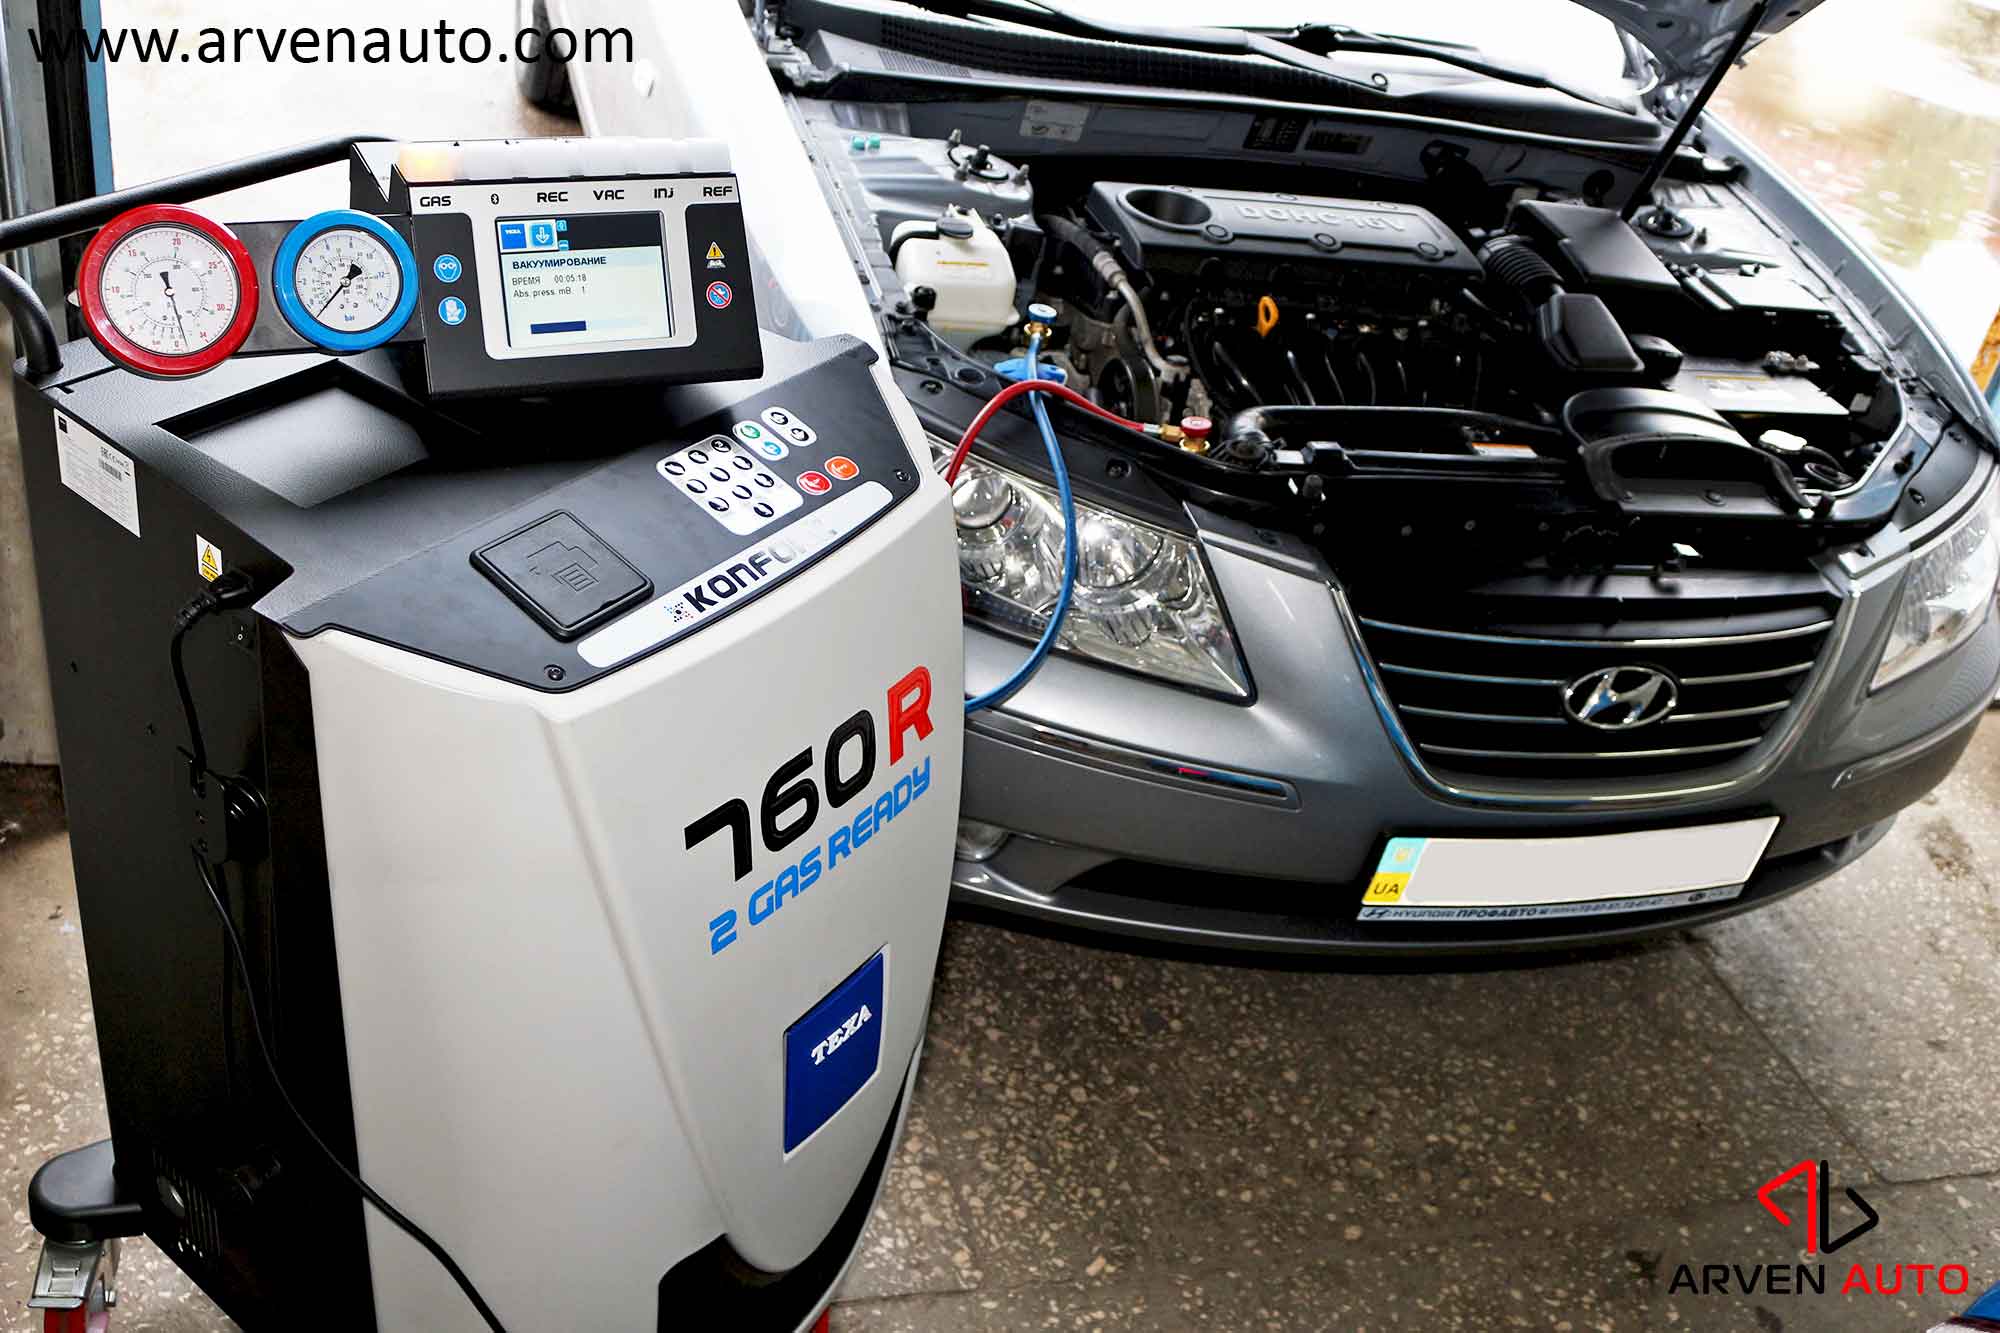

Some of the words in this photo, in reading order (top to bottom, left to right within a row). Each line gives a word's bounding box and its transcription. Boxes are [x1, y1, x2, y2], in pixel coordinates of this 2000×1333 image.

[537, 191, 568, 203] REC
[593, 189, 624, 201] VAC
[703, 186, 733, 197] REF
[420, 195, 451, 207] GAS
[512, 256, 607, 270] ВАКУУМИРОВАНИЕ
[512, 275, 541, 286] ВРЕМЯ
[709, 908, 737, 956] 2
[748, 845, 822, 926] GAS
[828, 755, 930, 871] READY
[1373, 883, 1400, 895] UA
[811, 1004, 872, 1066] TEXA
